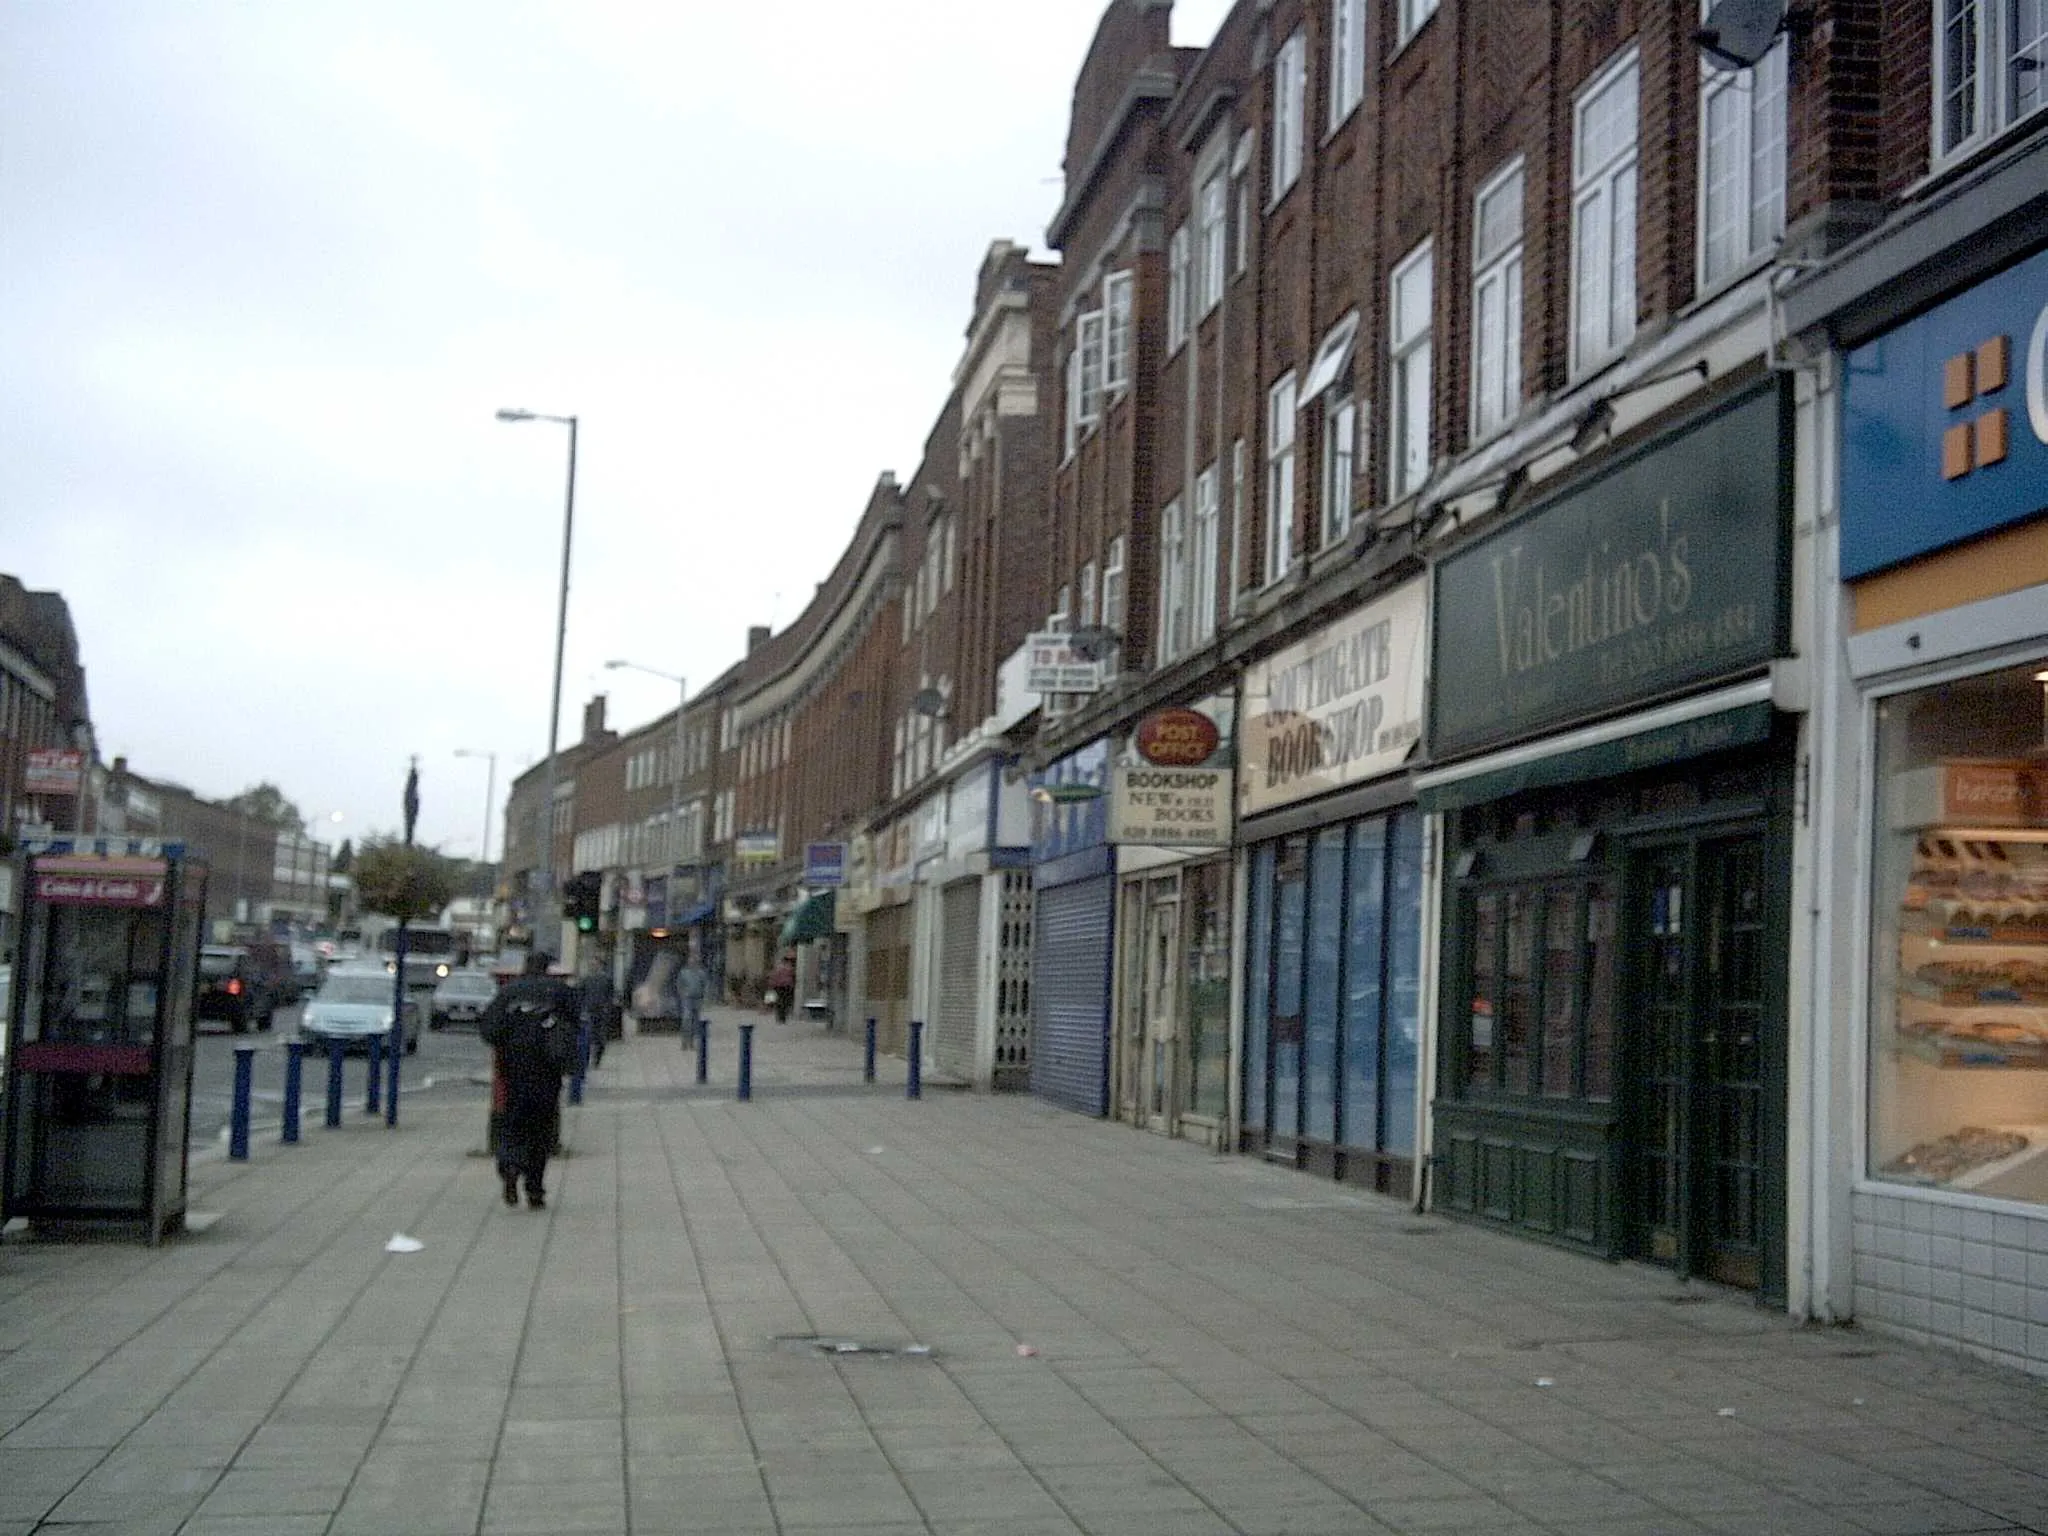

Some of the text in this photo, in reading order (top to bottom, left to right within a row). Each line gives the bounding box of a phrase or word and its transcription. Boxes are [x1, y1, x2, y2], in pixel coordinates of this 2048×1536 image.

[1491, 498, 1691, 676] Valentino's
[1127, 773, 1218, 789] BOOKSHOP
[1128, 791, 1174, 806] NEW
[1155, 807, 1215, 822] BOOKS
